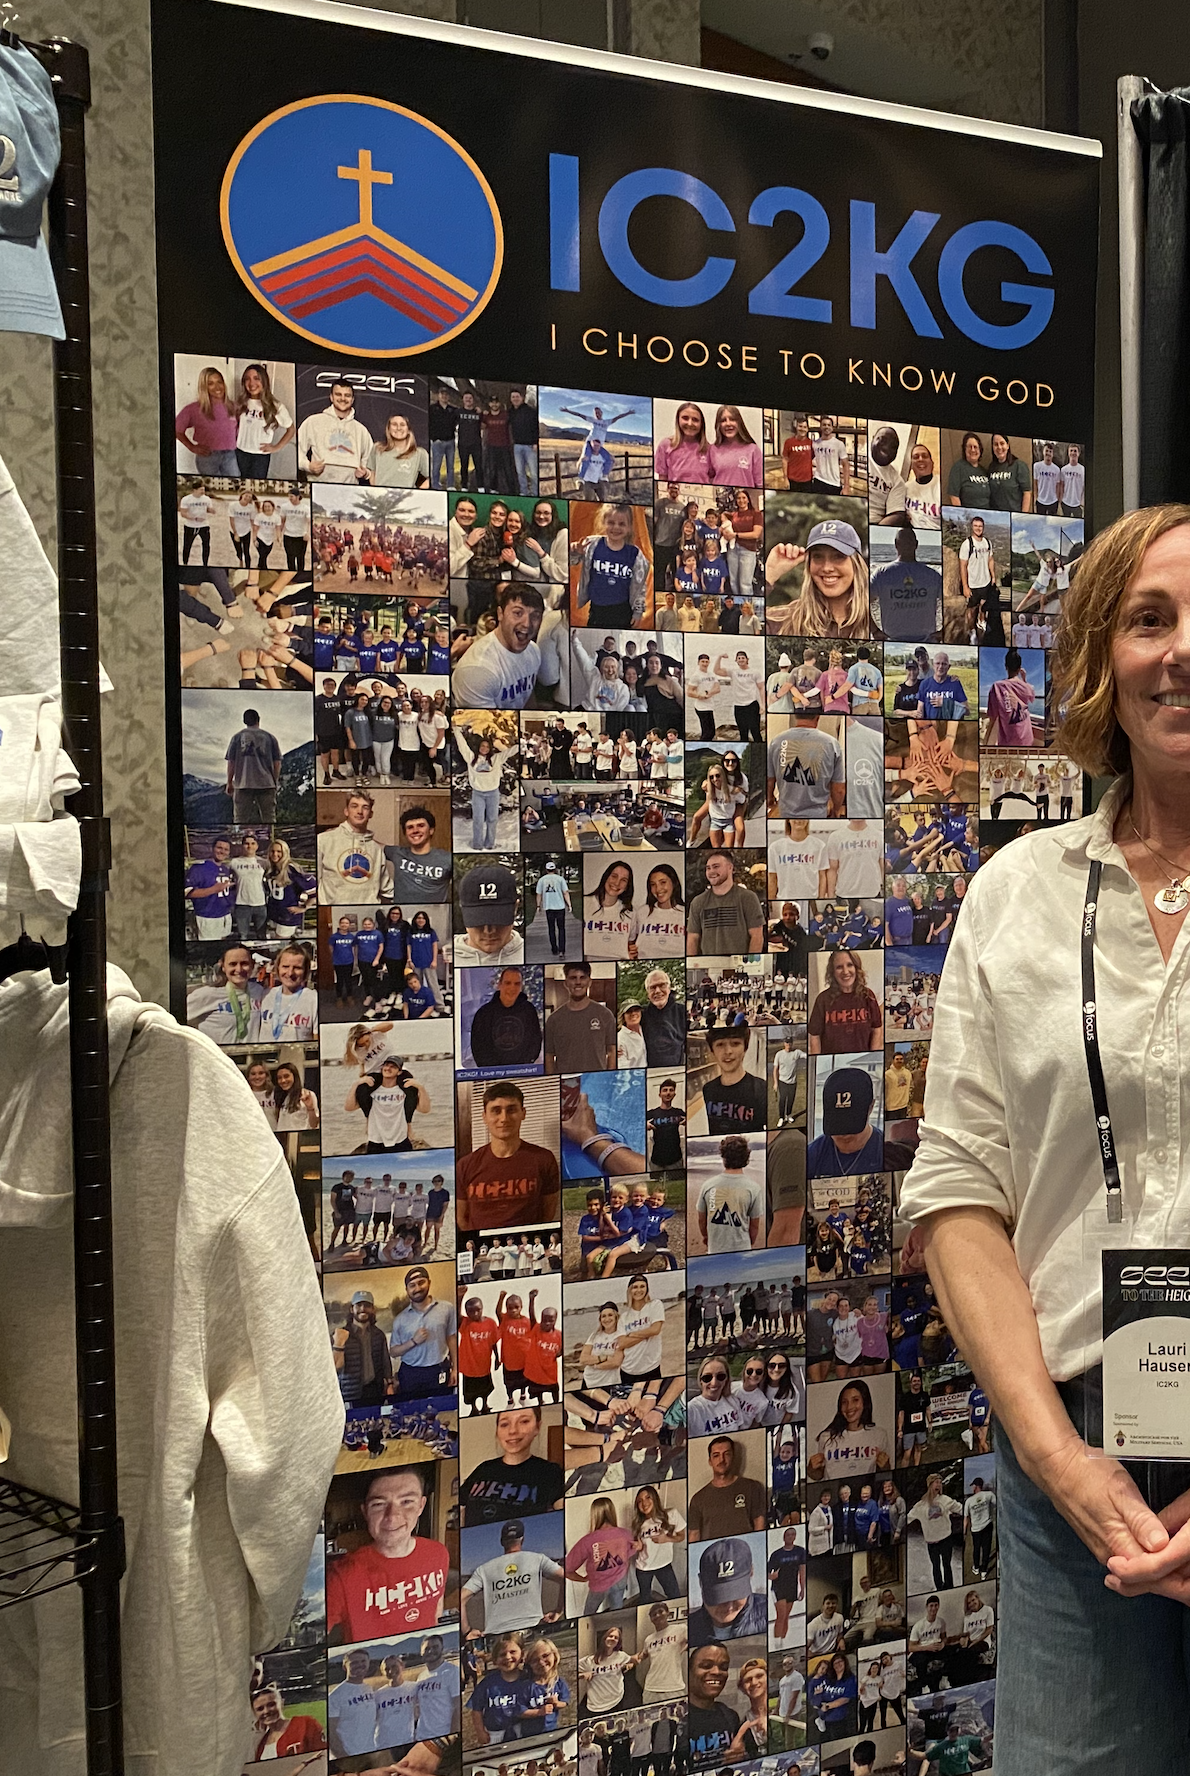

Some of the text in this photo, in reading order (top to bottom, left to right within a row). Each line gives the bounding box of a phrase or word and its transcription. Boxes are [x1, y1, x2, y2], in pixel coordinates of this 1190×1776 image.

[0, 134, 19, 190] 2
[549, 152, 1055, 350] IC2KG
[550, 324, 1055, 409] I CHOOSE TO KNOW GOD
[822, 523, 837, 536] 12
[400, 858, 443, 879] IC2KG
[479, 882, 498, 898] 12
[1084, 912, 1094, 937] focus
[1086, 1014, 1096, 1041] focus
[836, 1092, 852, 1108] 12
[1101, 1130, 1112, 1159] focus
[826, 1187, 850, 1197] GOD
[1121, 1288, 1139, 1301] TO
[1140, 1288, 1164, 1301] THE
[1148, 1341, 1187, 1356] Lauri
[932, 1392, 968, 1404] WELCOME
[718, 1561, 735, 1576] 12
[365, 1569, 444, 1612] IC2KG
[492, 1573, 532, 1592] IC2KG
